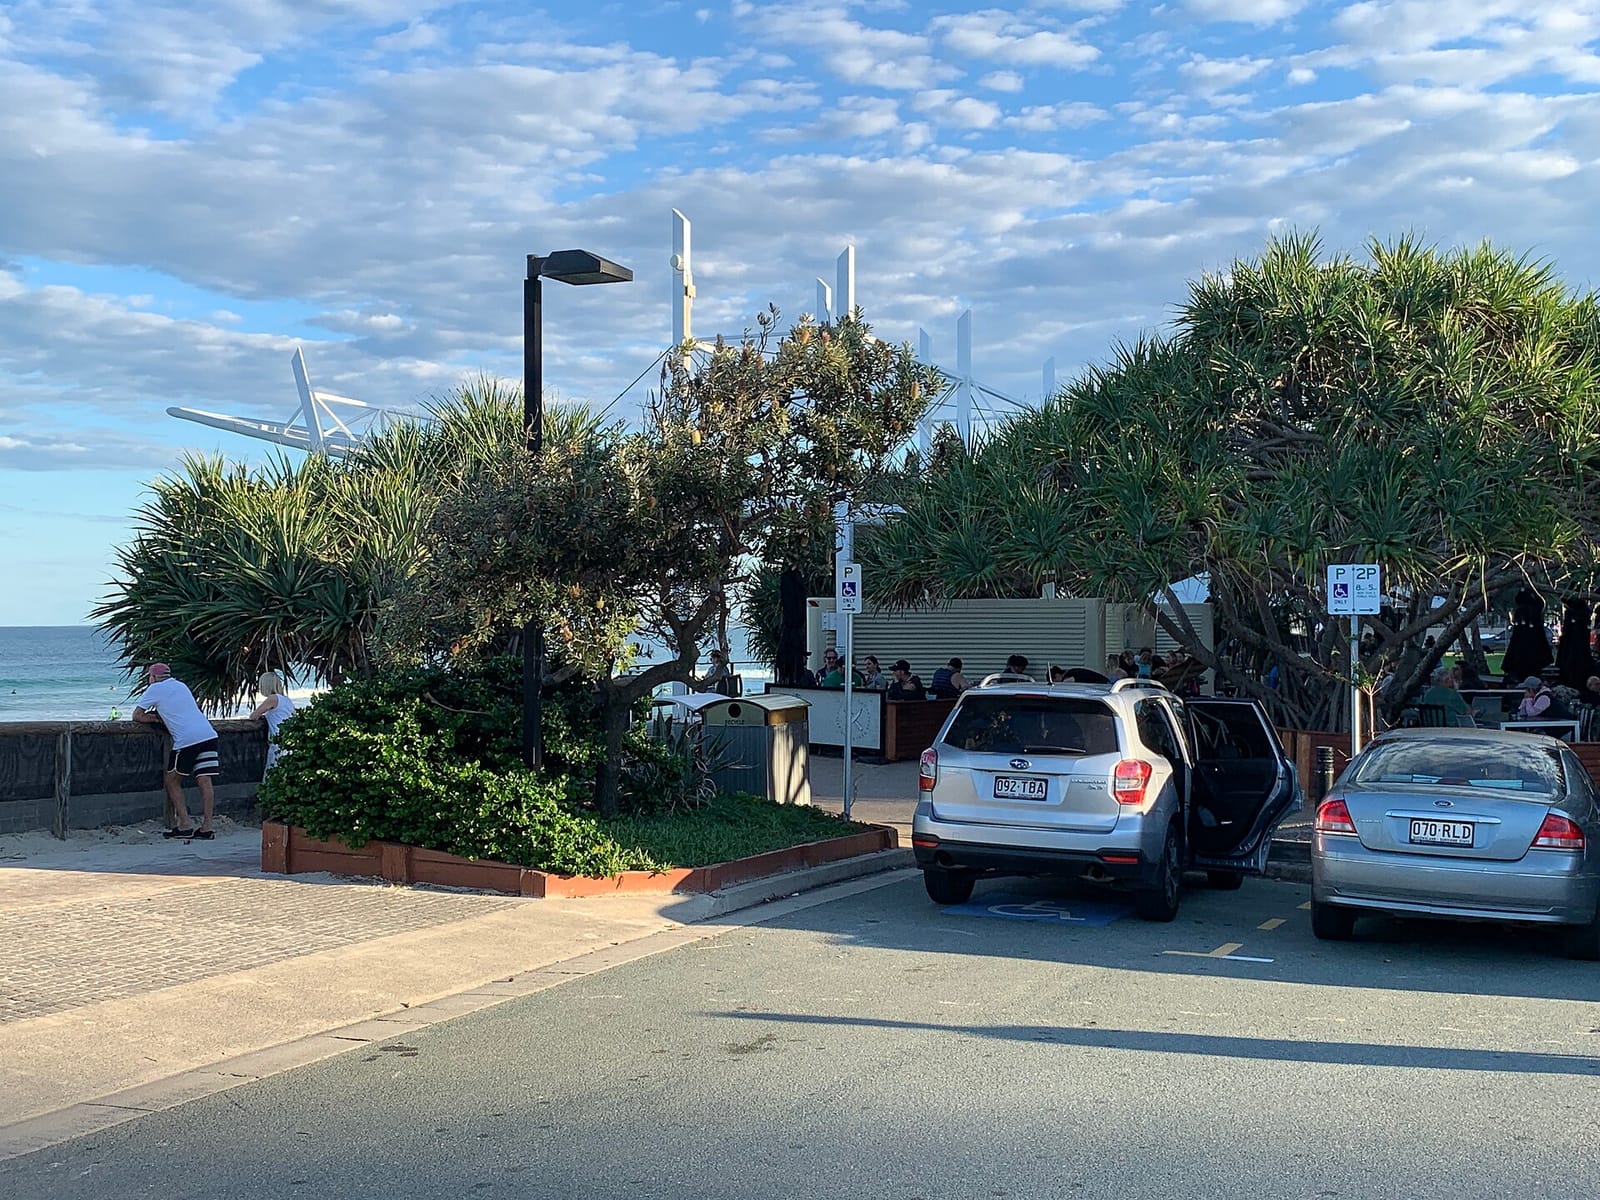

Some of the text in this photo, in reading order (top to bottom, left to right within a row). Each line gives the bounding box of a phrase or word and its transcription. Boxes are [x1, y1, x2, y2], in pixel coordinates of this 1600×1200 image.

[844, 567, 853, 578] P
[1336, 568, 1345, 580] P
[1356, 568, 1376, 580] 2P
